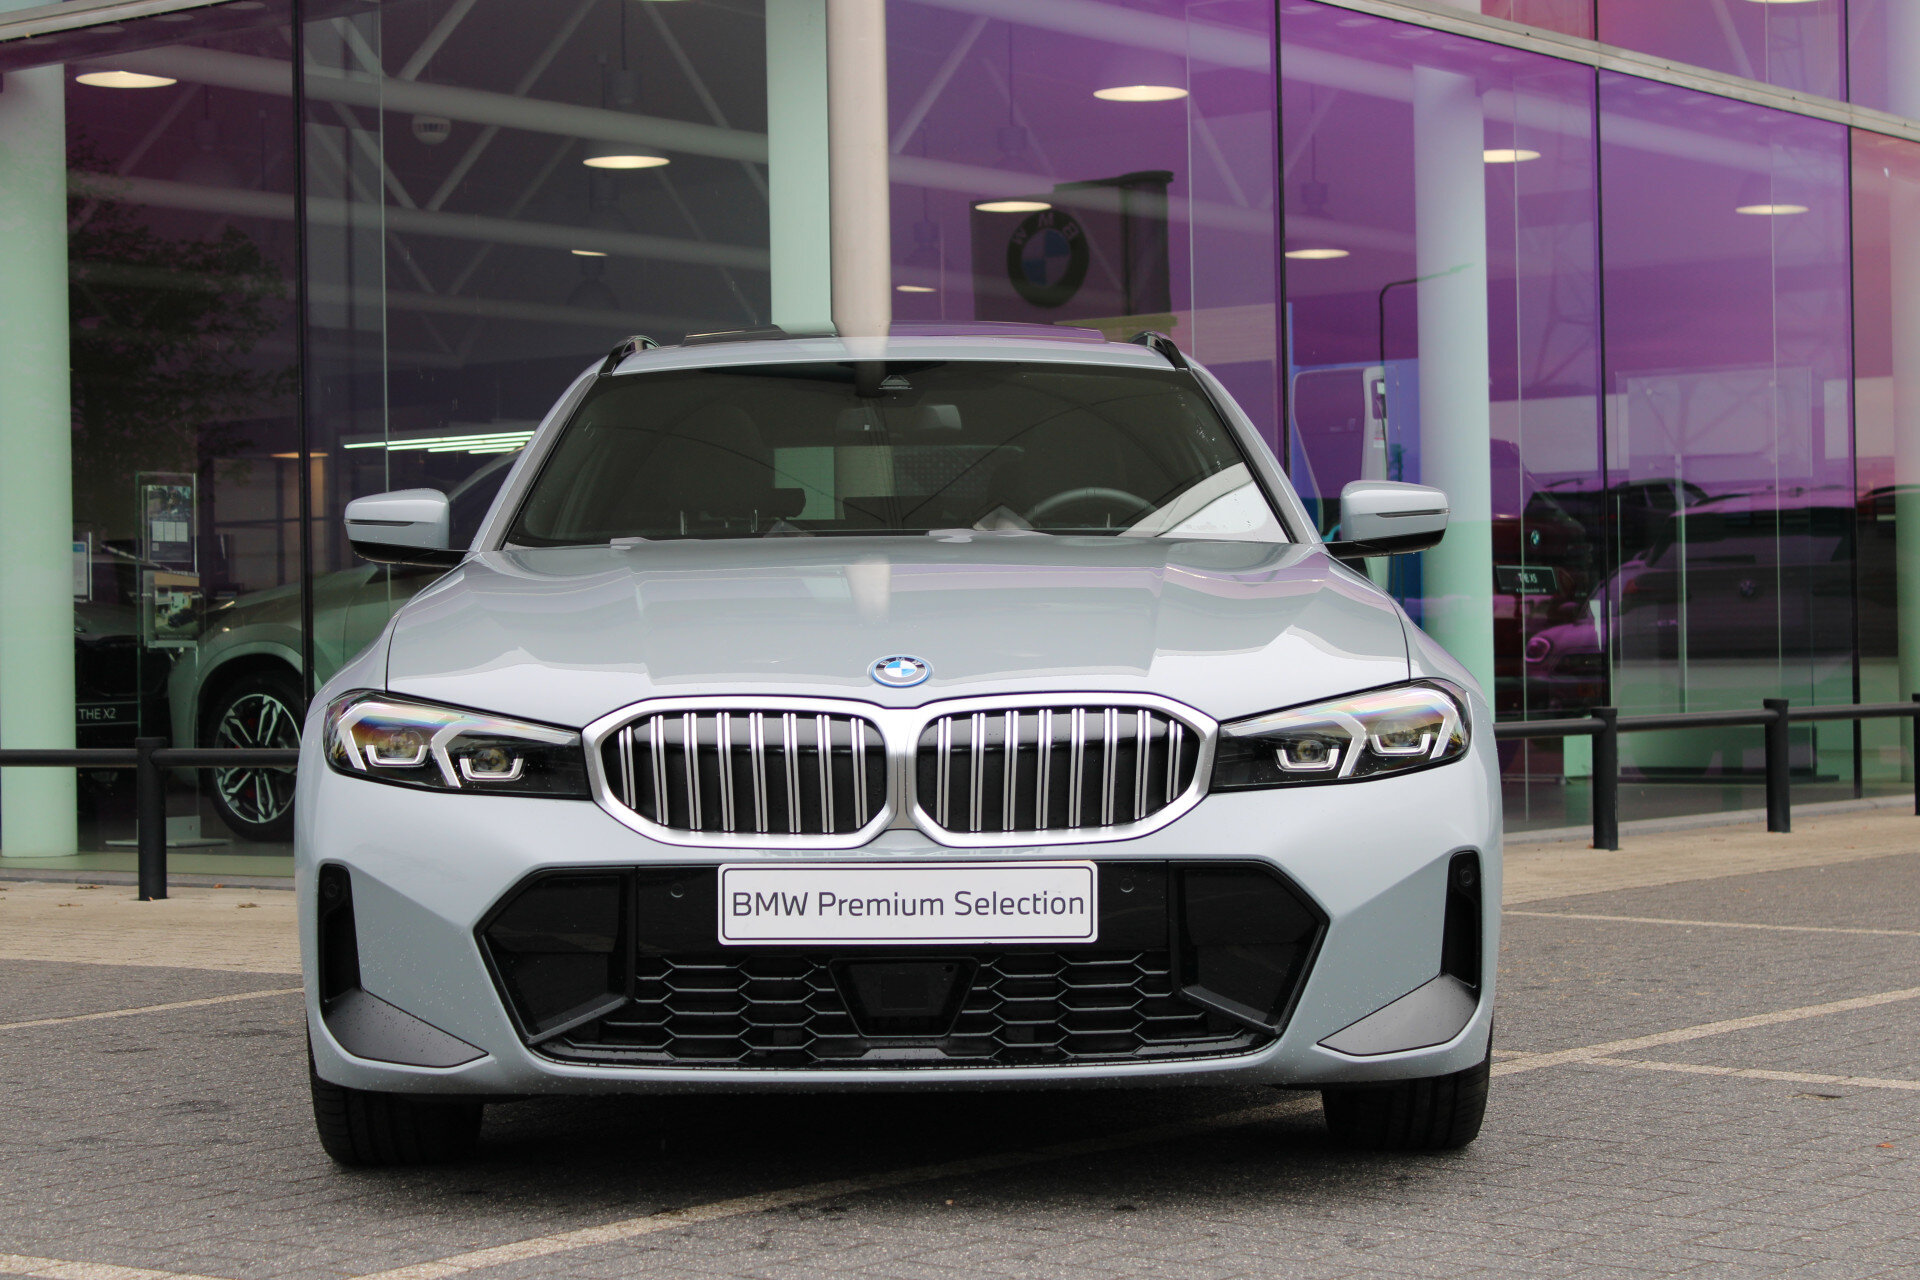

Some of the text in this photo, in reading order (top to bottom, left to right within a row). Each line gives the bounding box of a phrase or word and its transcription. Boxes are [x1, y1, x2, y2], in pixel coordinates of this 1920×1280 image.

[78, 707, 117, 720] THE X2
[731, 890, 1085, 917] BMW Premium Selection
